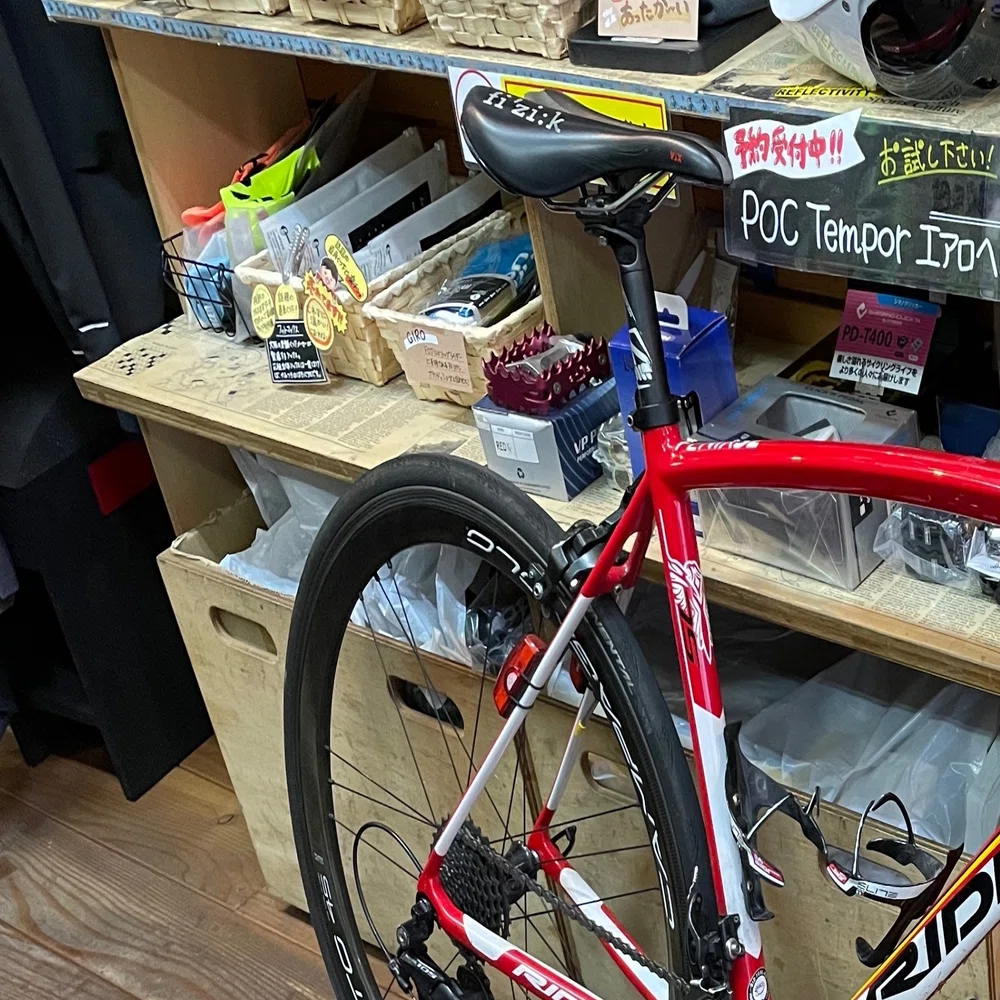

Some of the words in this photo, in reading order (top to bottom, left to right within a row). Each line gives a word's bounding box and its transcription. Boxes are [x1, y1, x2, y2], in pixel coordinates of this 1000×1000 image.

[776, 86, 871, 98] REFLECTIVITY
[742, 190, 800, 248] POC
[805, 201, 912, 265] Tempor
[406, 329, 427, 346] GIRO
[841, 324, 894, 348] PD-T400
[573, 435, 590, 455] VP
